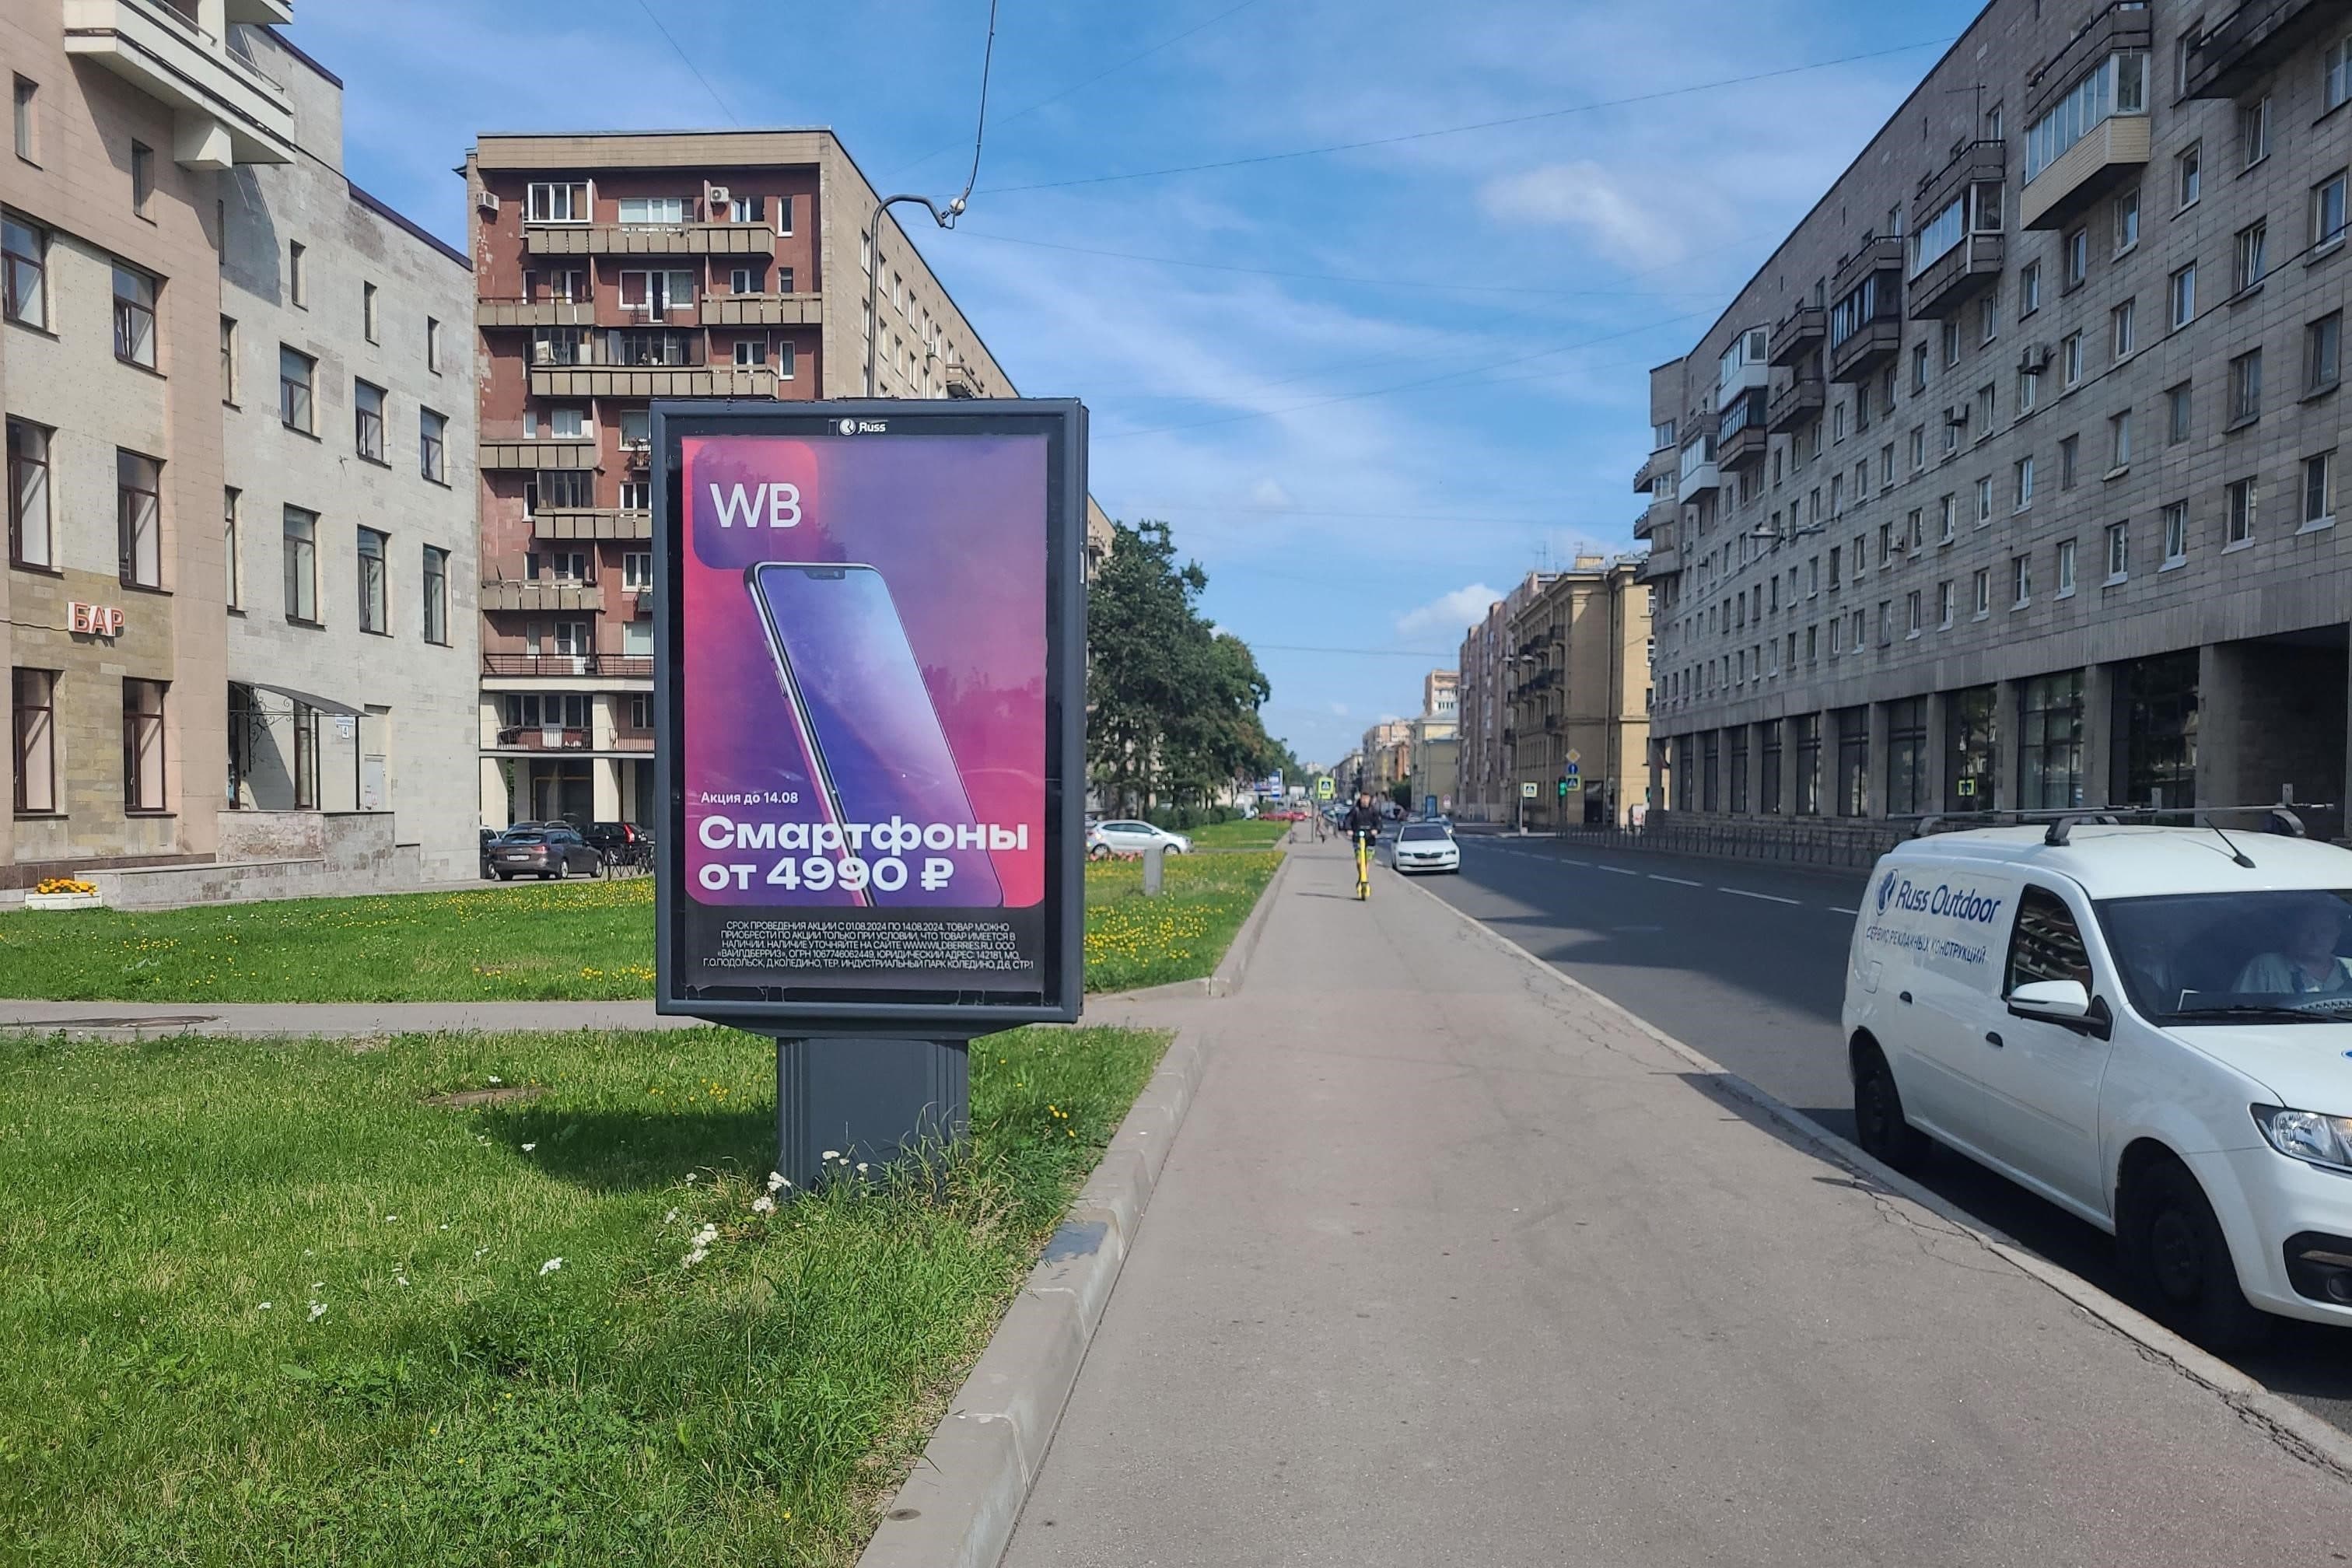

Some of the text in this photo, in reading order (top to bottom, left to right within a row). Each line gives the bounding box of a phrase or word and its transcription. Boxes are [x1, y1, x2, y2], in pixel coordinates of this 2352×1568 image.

[857, 422, 886, 434] Russ
[709, 482, 802, 528] WB
[68, 601, 124, 636] БАР
[701, 791, 798, 806] Акция до 14.08
[698, 814, 1028, 857] Смартфоны
[698, 863, 757, 891] от
[766, 856, 908, 891] 4990
[1895, 880, 2001, 924] Russ Outdoor
[726, 921, 749, 930] СРОК
[751, 921, 807, 931] ПРОВЕДЕНИЯ
[807, 922, 837, 933] АКЦИИ
[845, 922, 887, 931] 01.08.2024
[887, 922, 901, 931] ПО
[947, 922, 974, 932] ТОВАР
[975, 922, 1010, 932] МОЖНО
[721, 930, 777, 940] ПРИОБРЕСТИ
[778, 930, 791, 940] ПО
[792, 930, 821, 941] АКЦИИ
[824, 931, 856, 940] ТОЛЬКО
[857, 931, 875, 940] ПРИ
[920, 932, 939, 941] ЧТО
[940, 932, 967, 941] ТОВАР
[968, 932, 1009, 941] ИМЕЕТСЯ
[1010, 933, 1016, 941] В
[767, 940, 808, 949] НАЛИЧИЕ
[809, 940, 859, 950] УТОЧНЯЙТЕ
[859, 940, 872, 950] НА
[873, 940, 901, 950] САЙТЕ
[995, 941, 1016, 950] ООО
[788, 949, 811, 958] ОГРН
[877, 950, 943, 960] ЮРИДИЧЕСКИЙ
[841, 958, 923, 969] ИНДУСТРИАЛЬНЫЙ
[924, 959, 947, 968] ПАРК
